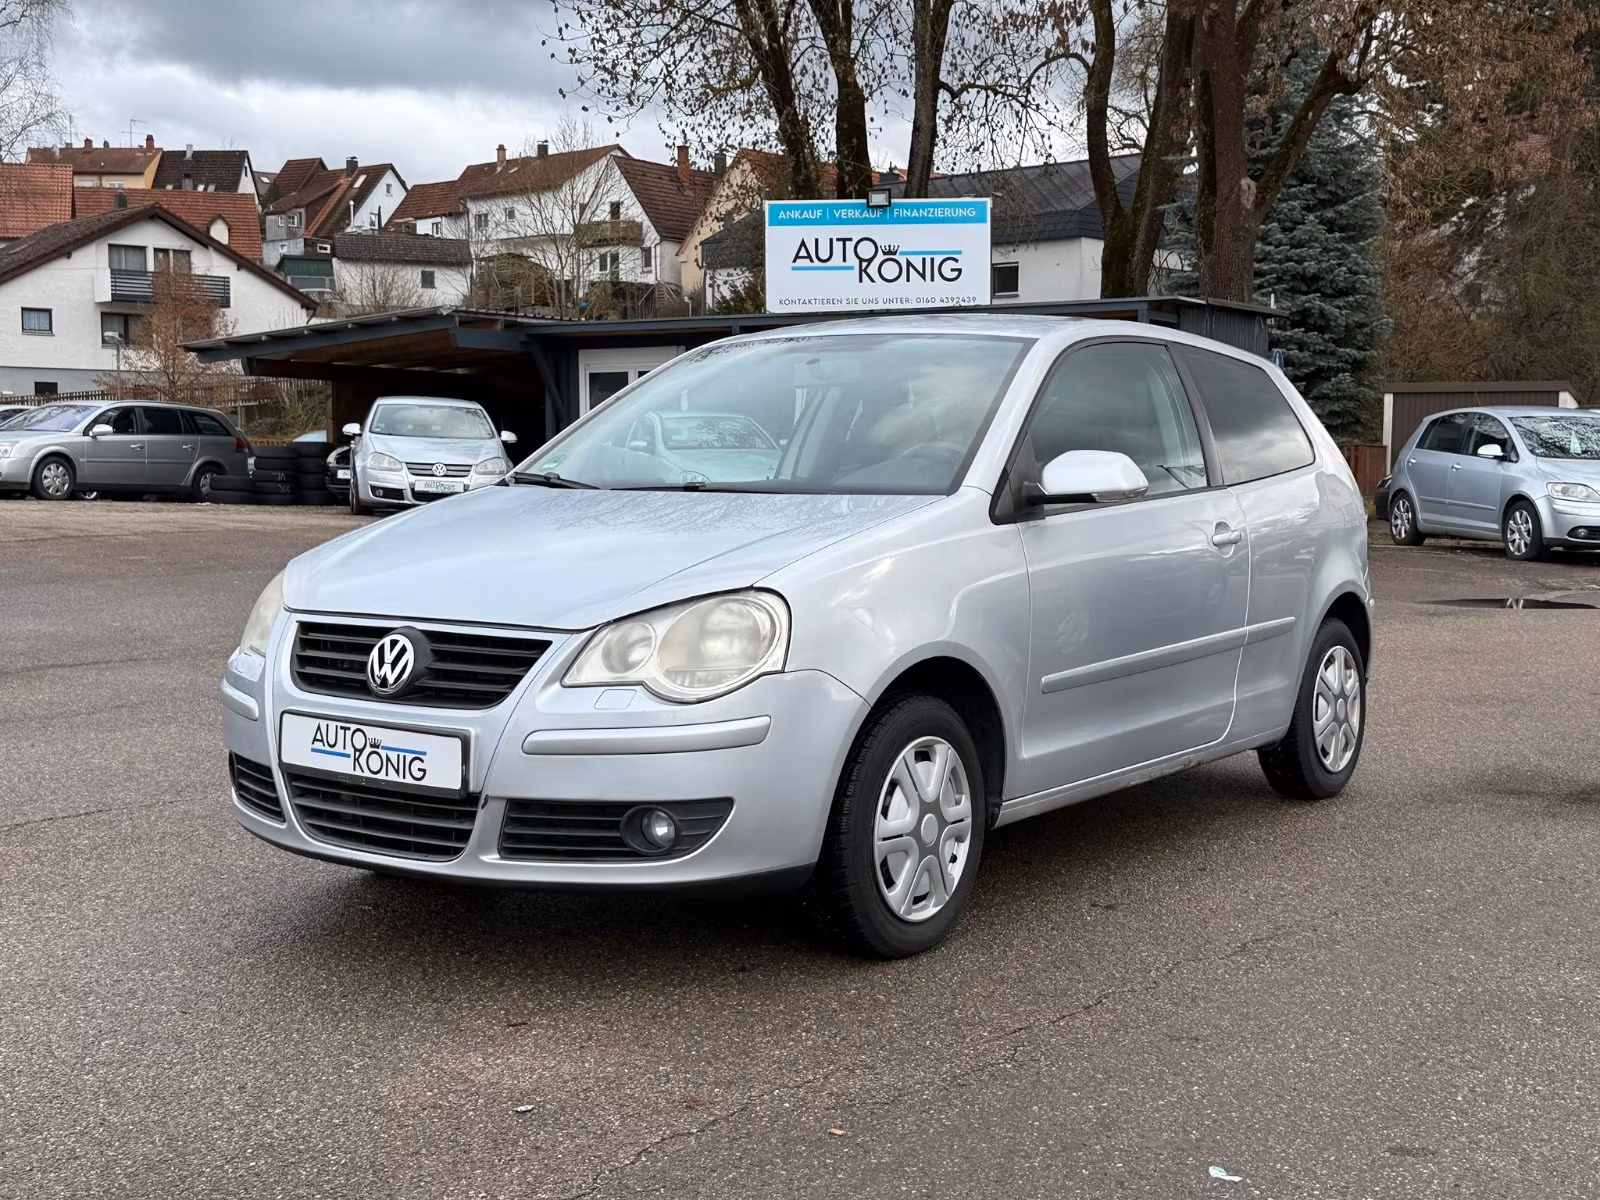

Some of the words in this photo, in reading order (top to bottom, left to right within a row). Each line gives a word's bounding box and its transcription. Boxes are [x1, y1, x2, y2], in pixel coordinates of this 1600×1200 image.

[778, 209, 823, 219] ANKAUF
[833, 208, 883, 219] VERKAUF
[893, 207, 976, 218] FINANZIERUNG
[792, 236, 879, 264] AUTO
[778, 297, 843, 306] KONTAKTIEREN
[846, 297, 858, 305] SIE
[862, 297, 880, 305] UNS
[882, 296, 913, 305] UNTER:
[915, 296, 937, 304] 0160
[368, 634, 414, 693] VW
[311, 722, 368, 751] AUTO
